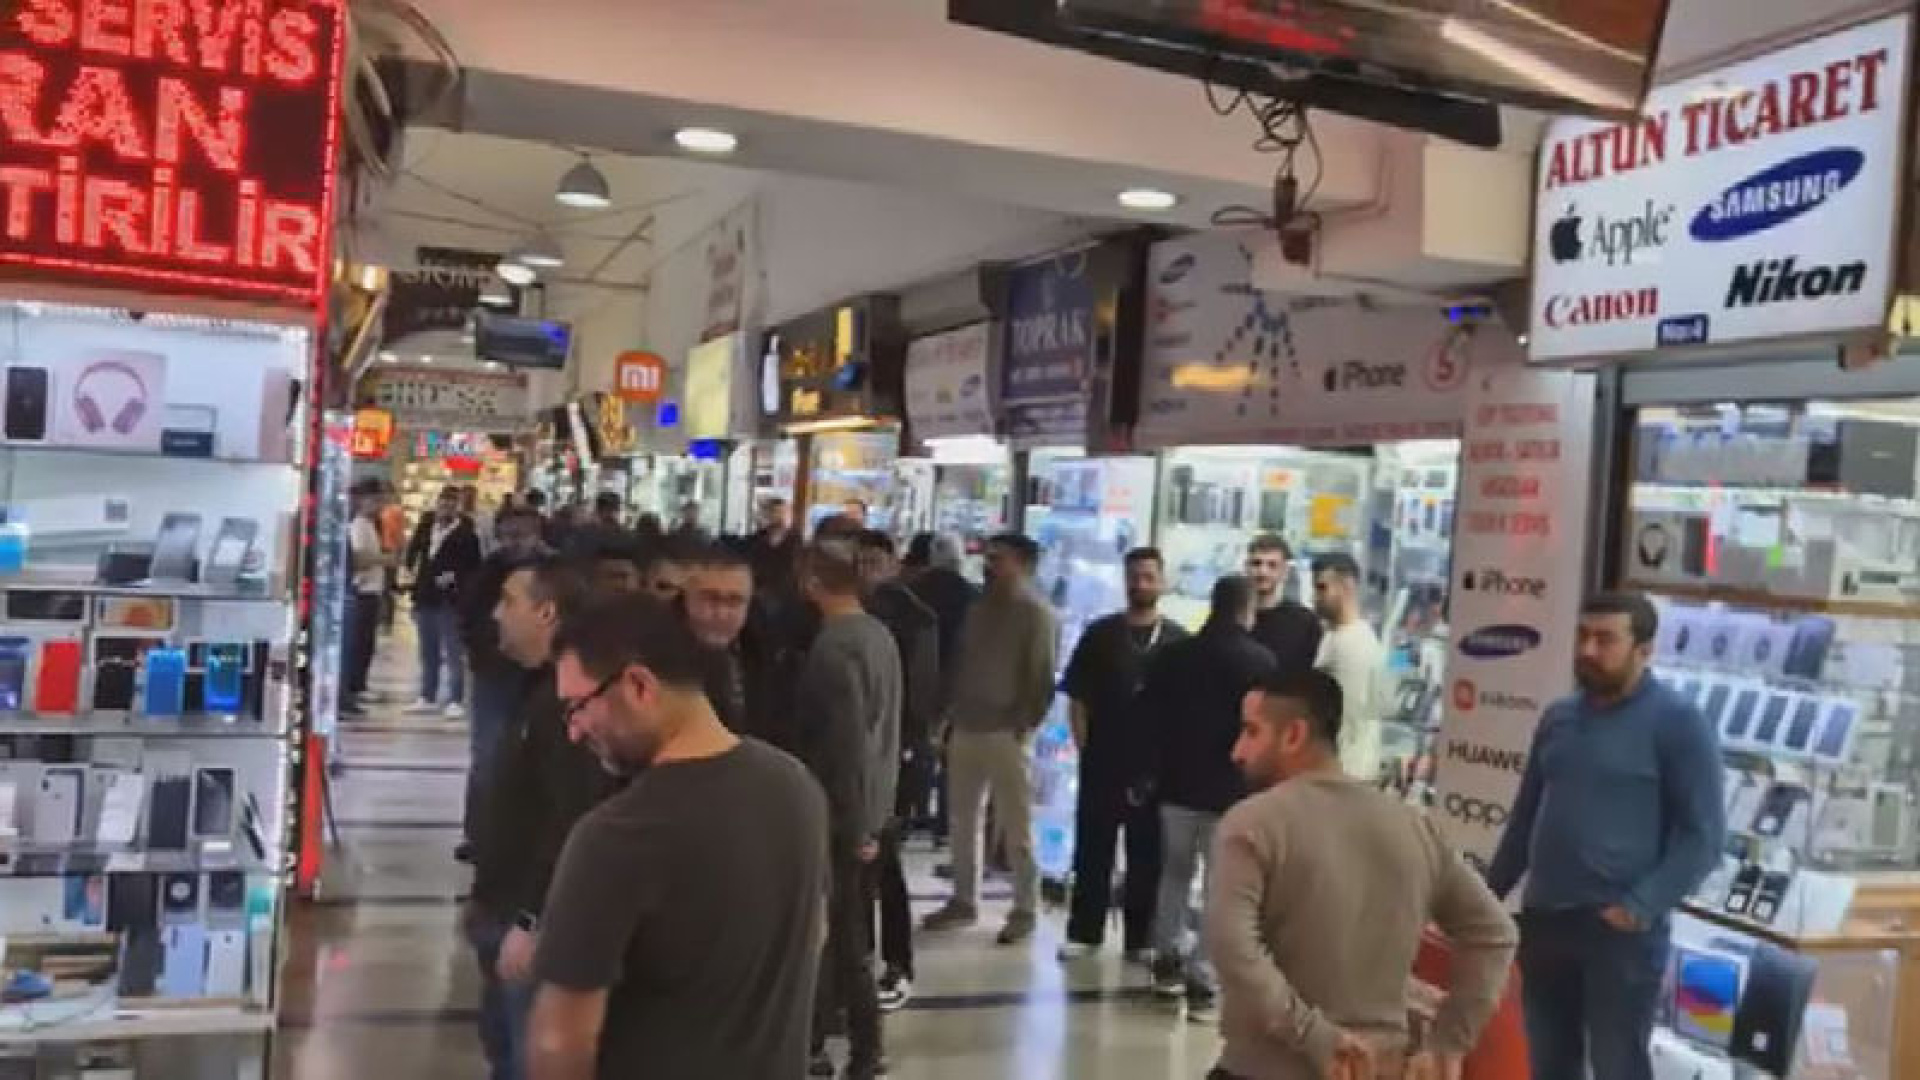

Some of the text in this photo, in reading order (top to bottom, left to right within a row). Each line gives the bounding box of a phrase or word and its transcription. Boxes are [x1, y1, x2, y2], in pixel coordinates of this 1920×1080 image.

[1545, 48, 1888, 191] ALTUN TICARET
[1709, 169, 1842, 224] SAMSUNG
[1588, 200, 1670, 267] Apple
[1724, 254, 1867, 309] Nikon
[1544, 287, 1660, 329] Canon
[1011, 312, 1087, 354] TOPRAK
[1341, 361, 1406, 389] iPhone
[1480, 567, 1547, 597] iPhone
[1447, 740, 1524, 775] HUAWE
[1445, 793, 1508, 828] opp
